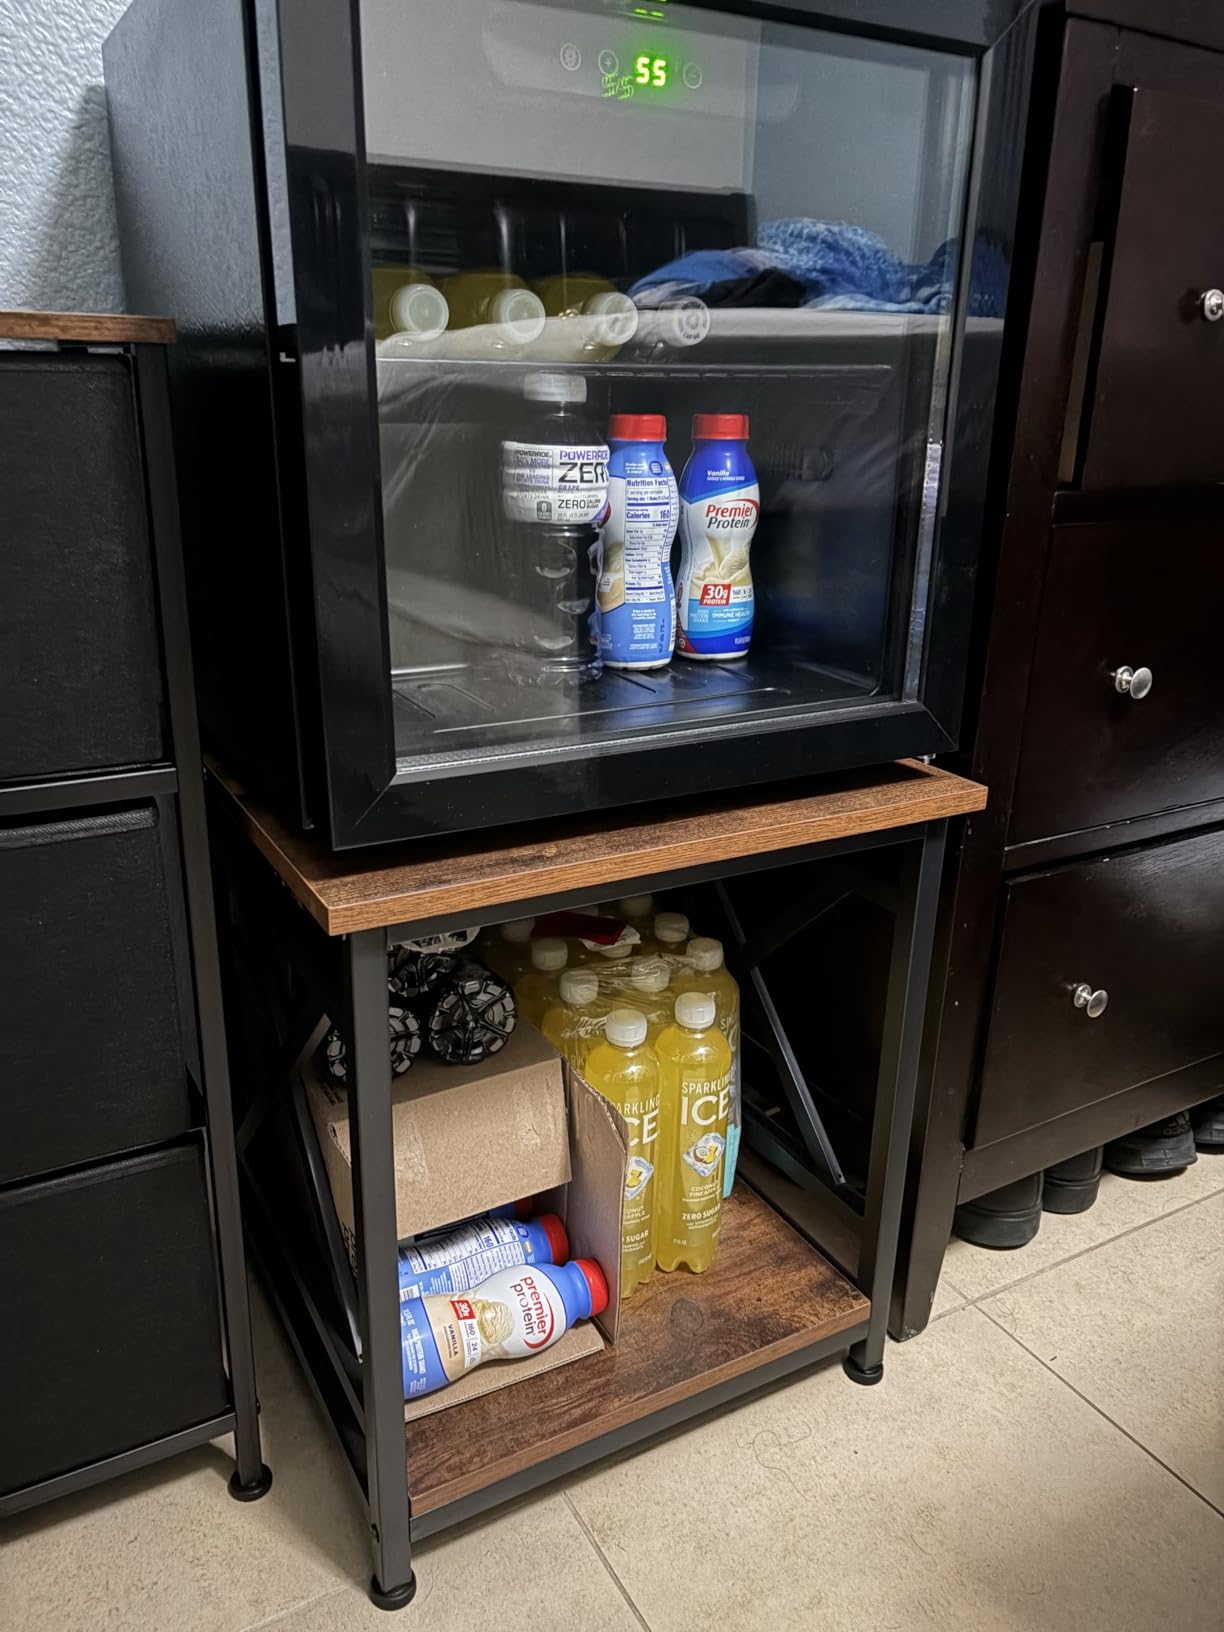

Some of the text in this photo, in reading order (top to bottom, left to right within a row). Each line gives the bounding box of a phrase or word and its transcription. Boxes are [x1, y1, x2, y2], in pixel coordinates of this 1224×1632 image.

[635, 56, 667, 87] 55
[559, 449, 608, 461] POWERADE
[706, 469, 730, 477] Vanilla
[626, 479, 654, 487] Nutrition
[557, 499, 586, 509] ZERO
[705, 503, 754, 518] Premier
[626, 511, 651, 519] Calories
[659, 509, 670, 519] 160
[706, 516, 750, 529] Protein
[704, 585, 729, 600] 30g
[681, 1074, 731, 1094] SPARKLIN
[616, 1093, 660, 1116] ARKLING
[681, 1084, 731, 1126] ICE
[623, 1107, 660, 1147] CE
[482, 1234, 495, 1248] 160
[625, 1229, 649, 1243] SUGAR
[509, 1283, 535, 1336] protein
[519, 1275, 548, 1336] premier
[466, 1322, 476, 1337] 160
[447, 1323, 459, 1357] VANILLA
[471, 1342, 479, 1352] 24
